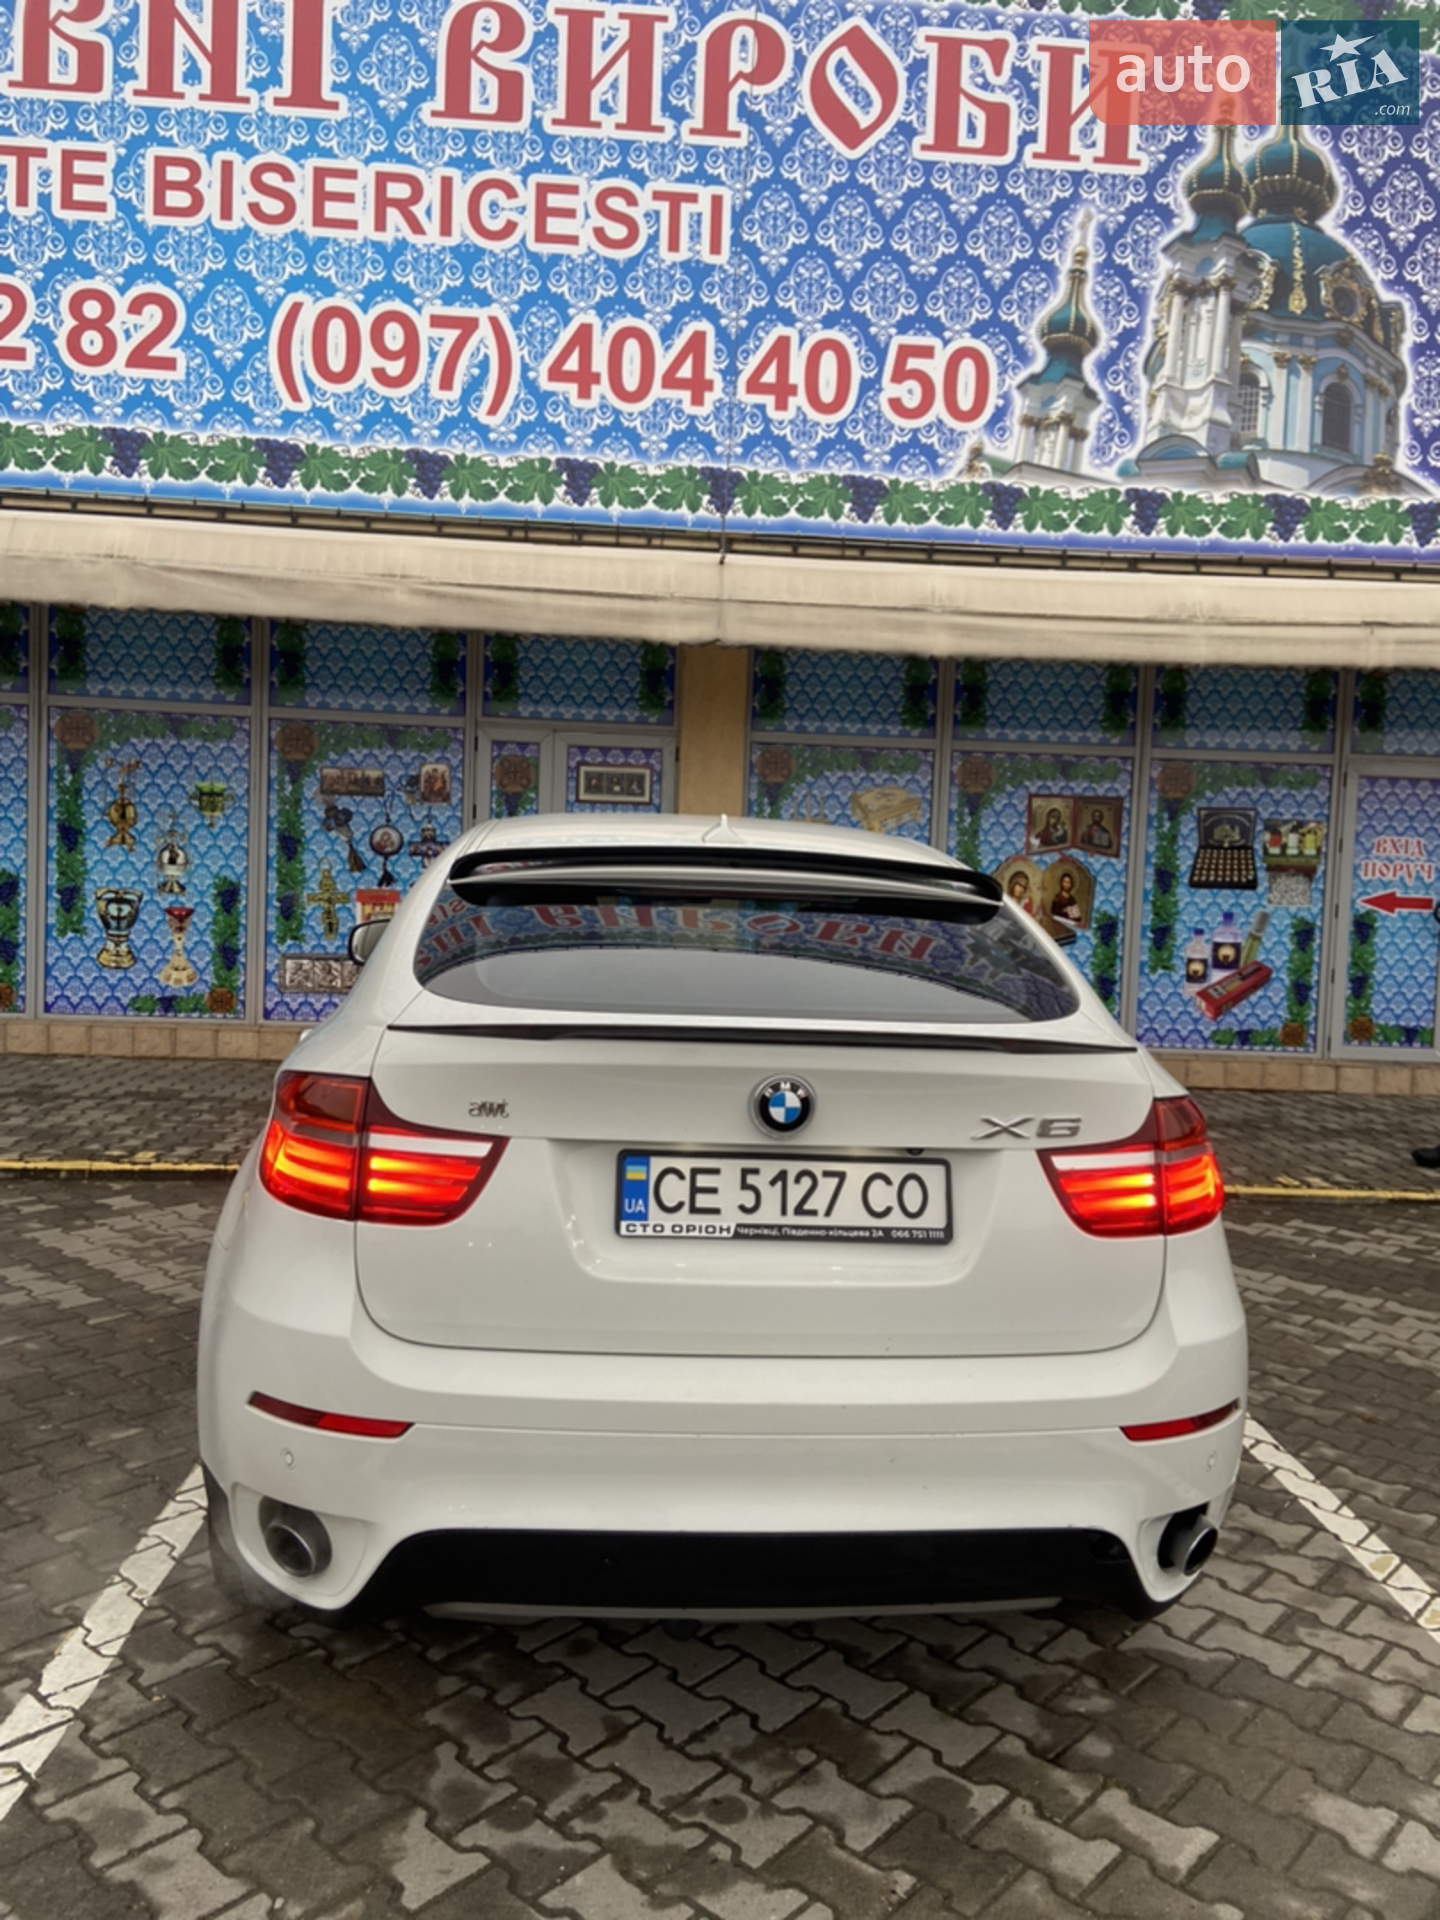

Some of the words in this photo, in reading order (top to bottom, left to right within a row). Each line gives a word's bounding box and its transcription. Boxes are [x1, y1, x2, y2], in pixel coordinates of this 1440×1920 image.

[430, 0, 1142, 168] ВИРОБИ
[0, 144, 107, 213] TE
[153, 154, 725, 256] BISERICESTI
[65, 287, 178, 372] 82
[277, 301, 513, 416] (097)
[547, 322, 714, 401] 404
[745, 335, 853, 416] 40
[888, 344, 990, 423] 50
[970, 1116, 1082, 1140] X6
[624, 1198, 646, 1213] UA
[652, 1166, 722, 1215] CE
[737, 1167, 847, 1217] 5127
[861, 1171, 929, 1220] CO
